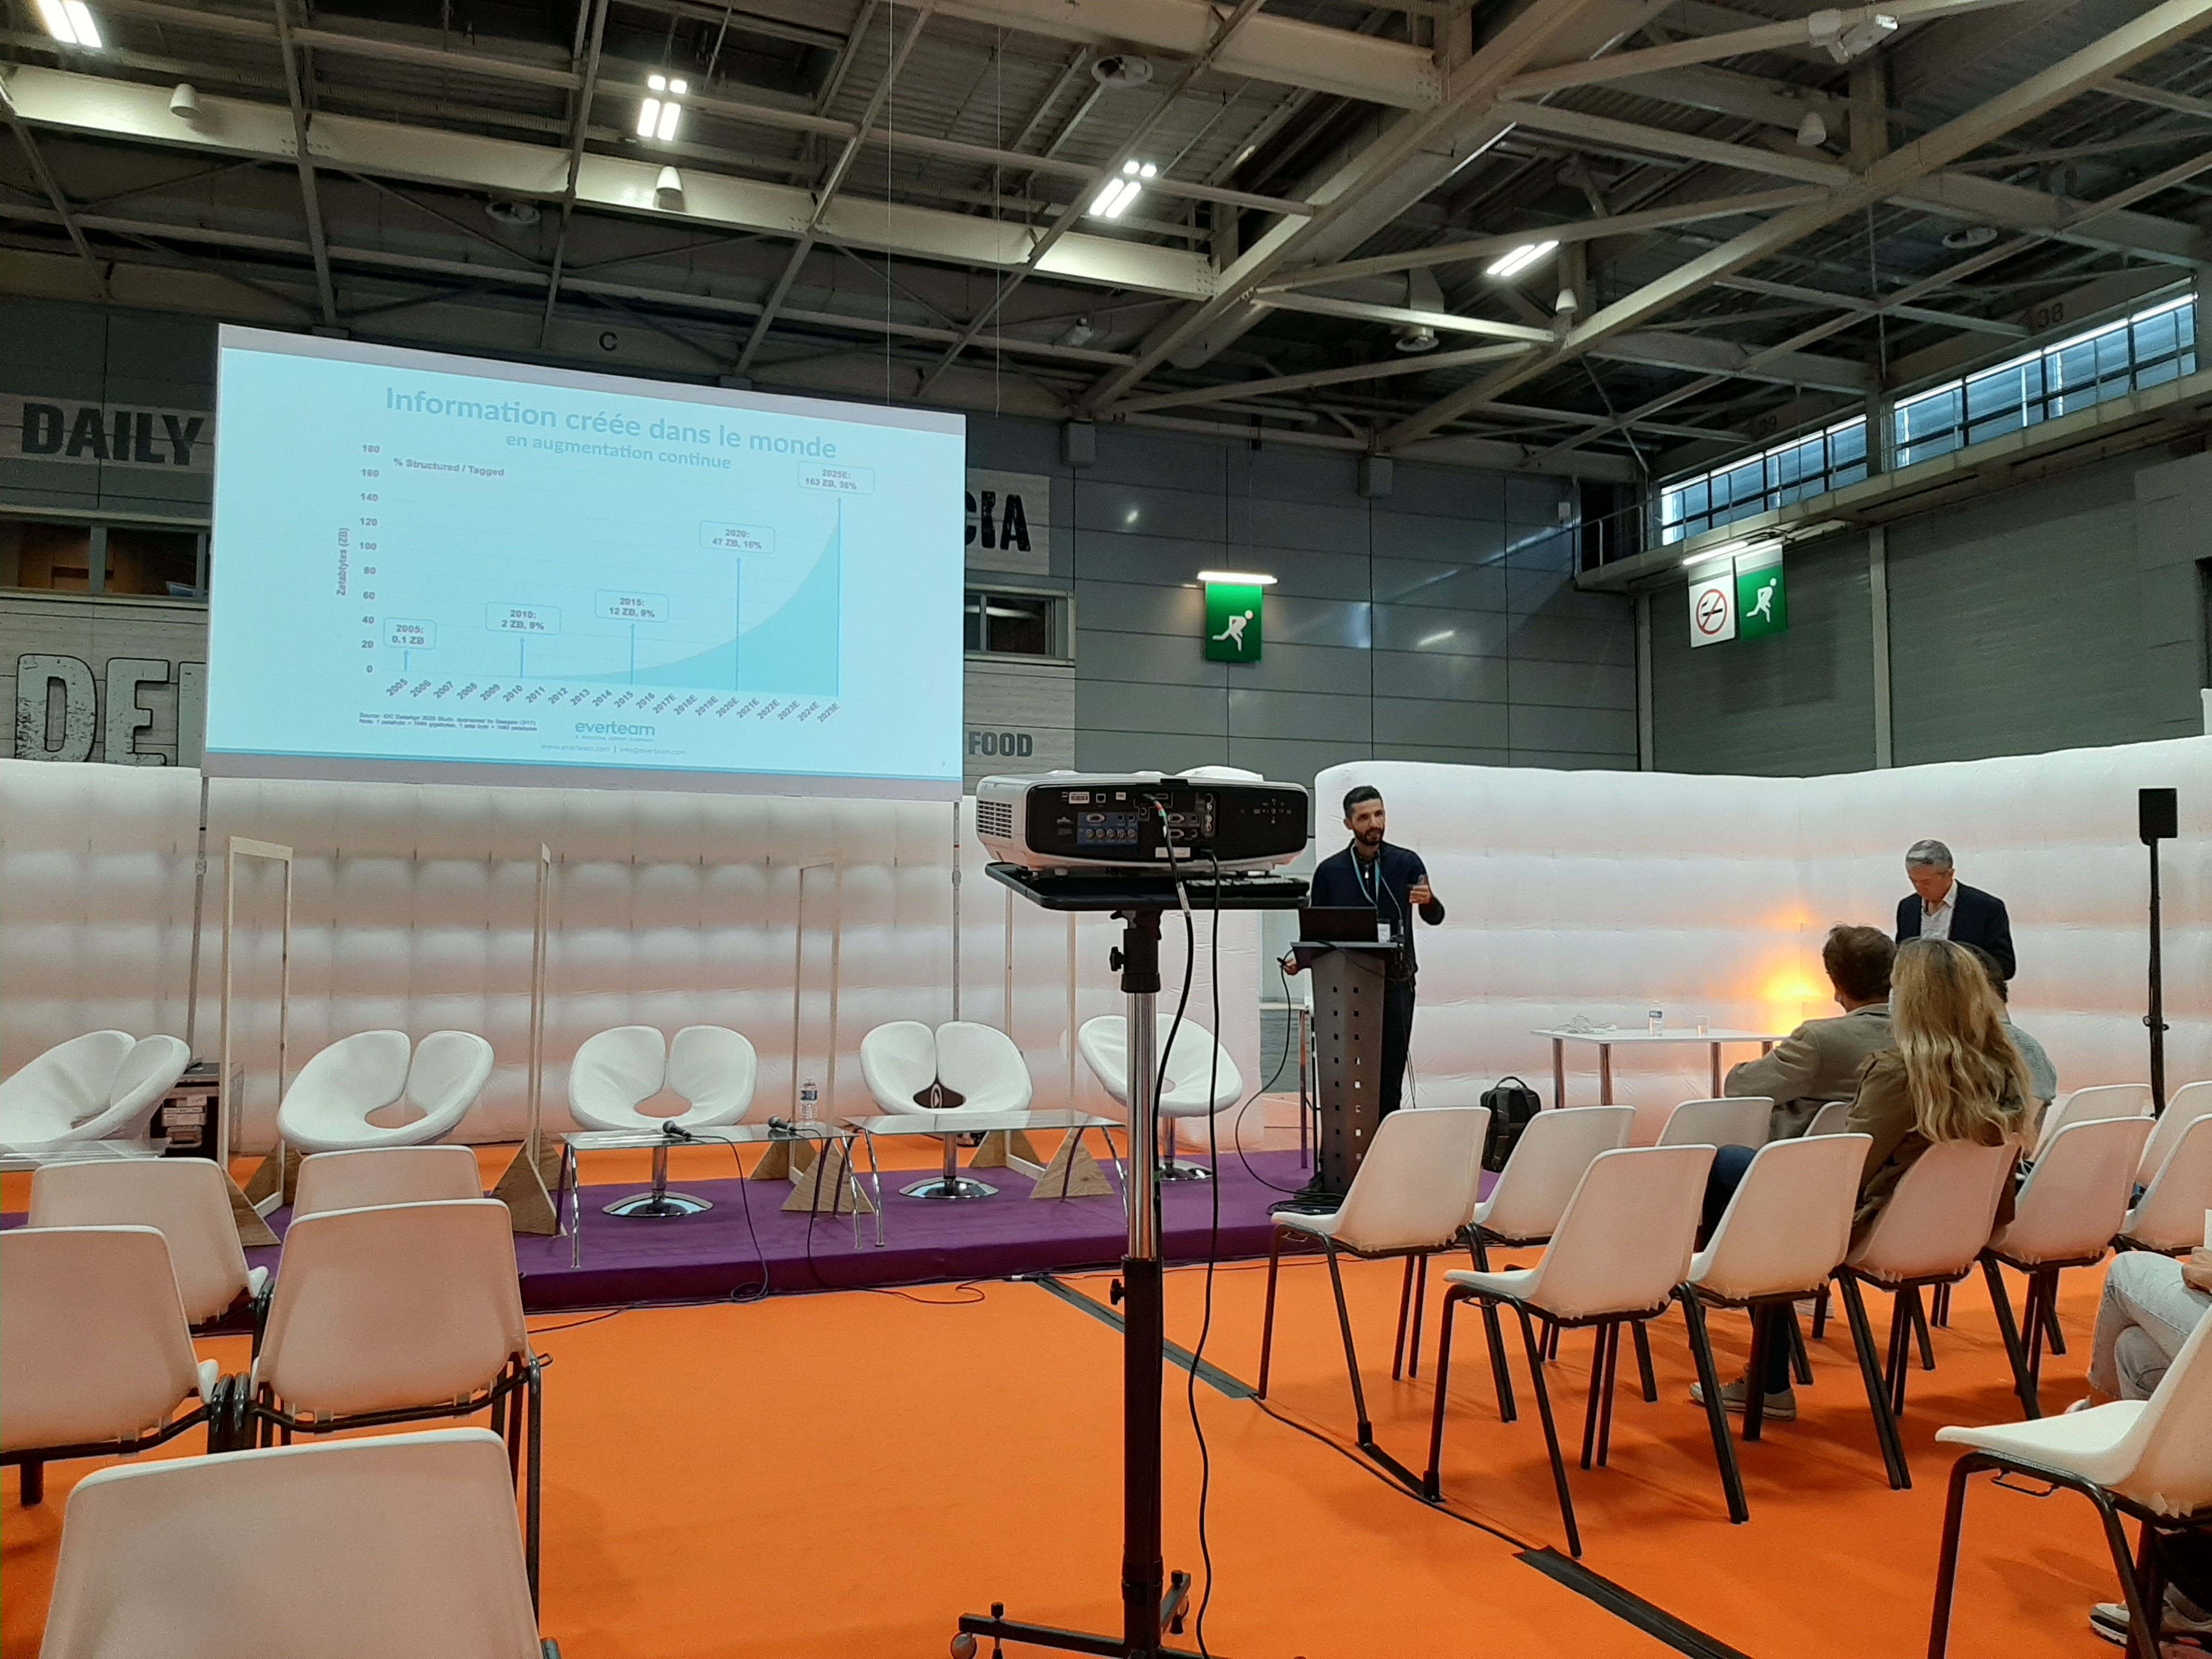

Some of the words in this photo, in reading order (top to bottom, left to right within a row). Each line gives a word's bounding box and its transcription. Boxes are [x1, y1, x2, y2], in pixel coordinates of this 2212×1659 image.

[599, 331, 618, 351] C
[387, 386, 556, 427] Information
[566, 411, 641, 436] créée
[649, 418, 710, 444] dans
[719, 425, 741, 448] le
[750, 434, 837, 458] monde
[21, 402, 205, 466] DAILY
[361, 445, 380, 454] 180
[506, 435, 527, 447] en
[533, 437, 653, 462] augmentation
[658, 450, 731, 469] continue
[361, 469, 380, 477] 160
[406, 459, 460, 472] Structured
[468, 465, 505, 477] Tagged
[360, 493, 379, 502] 140
[360, 518, 377, 527] 120
[725, 528, 749, 538] 2020:
[359, 542, 377, 551] 100
[712, 538, 723, 546] 47
[364, 567, 376, 575] 80
[363, 591, 375, 600] 60
[619, 597, 645, 607] 2015:
[362, 616, 375, 624] 40
[510, 610, 537, 619] 2010:
[396, 624, 424, 634] 2005:
[362, 640, 374, 648] 20
[392, 635, 407, 644] 0.1
[410, 636, 425, 645] ZB
[366, 665, 373, 674] 0
[386, 678, 408, 697] 2005
[410, 680, 432, 698] 2006
[433, 681, 455, 699] 2007
[456, 682, 478, 700] 2008
[479, 684, 501, 702] 2009
[503, 684, 524, 703] 2010
[525, 686, 546, 704] 2011
[548, 687, 569, 705] 2012
[569, 689, 591, 707] 2013
[591, 690, 613, 707] 2014
[614, 691, 634, 709] 2015
[635, 692, 656, 710] 2016
[575, 721, 654, 736] everteam
[968, 731, 1032, 757] FOOD
